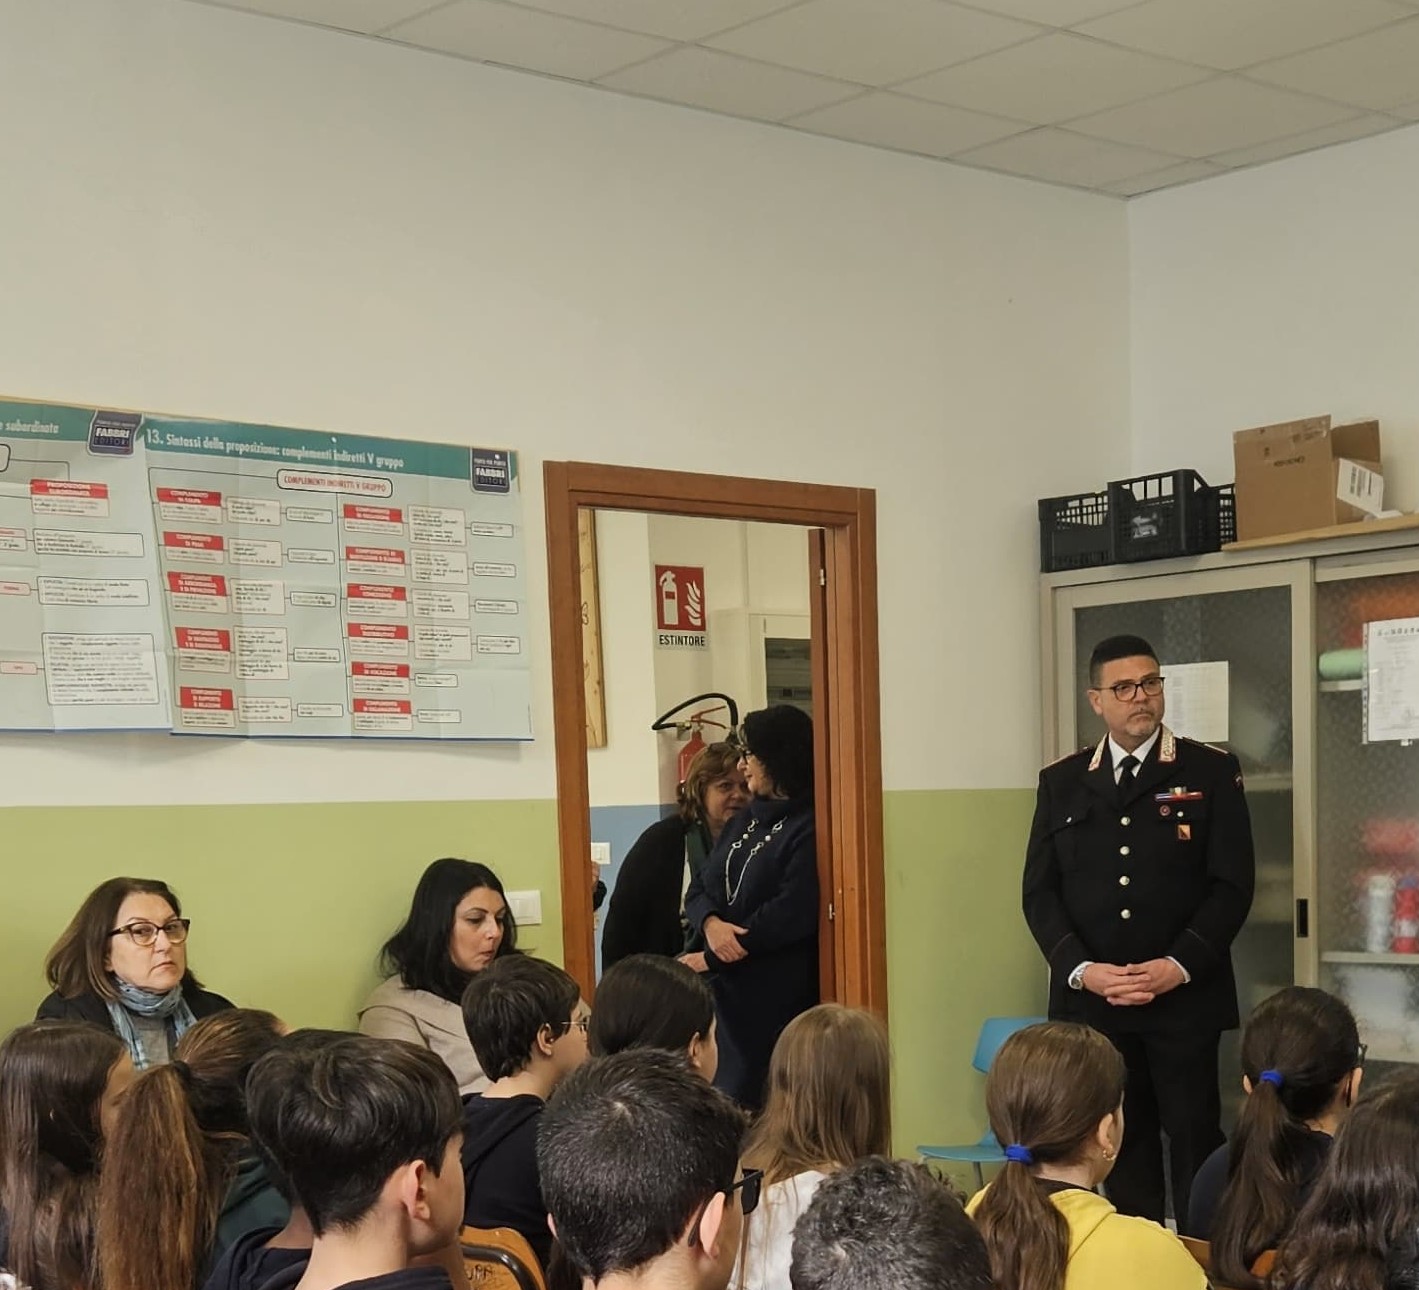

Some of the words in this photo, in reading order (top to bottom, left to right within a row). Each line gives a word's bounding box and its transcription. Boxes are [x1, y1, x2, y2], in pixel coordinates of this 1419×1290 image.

[95, 427, 130, 439] FABBRI
[146, 428, 164, 445] 13.
[166, 433, 201, 448] Sintassi
[203, 436, 224, 450] della
[226, 441, 280, 456] proposizione:
[282, 445, 332, 461] complementi
[333, 449, 366, 464] indiretti
[376, 456, 404, 470] gruppo
[475, 467, 505, 478] FABBRI
[659, 633, 706, 647] ESTINTORE
